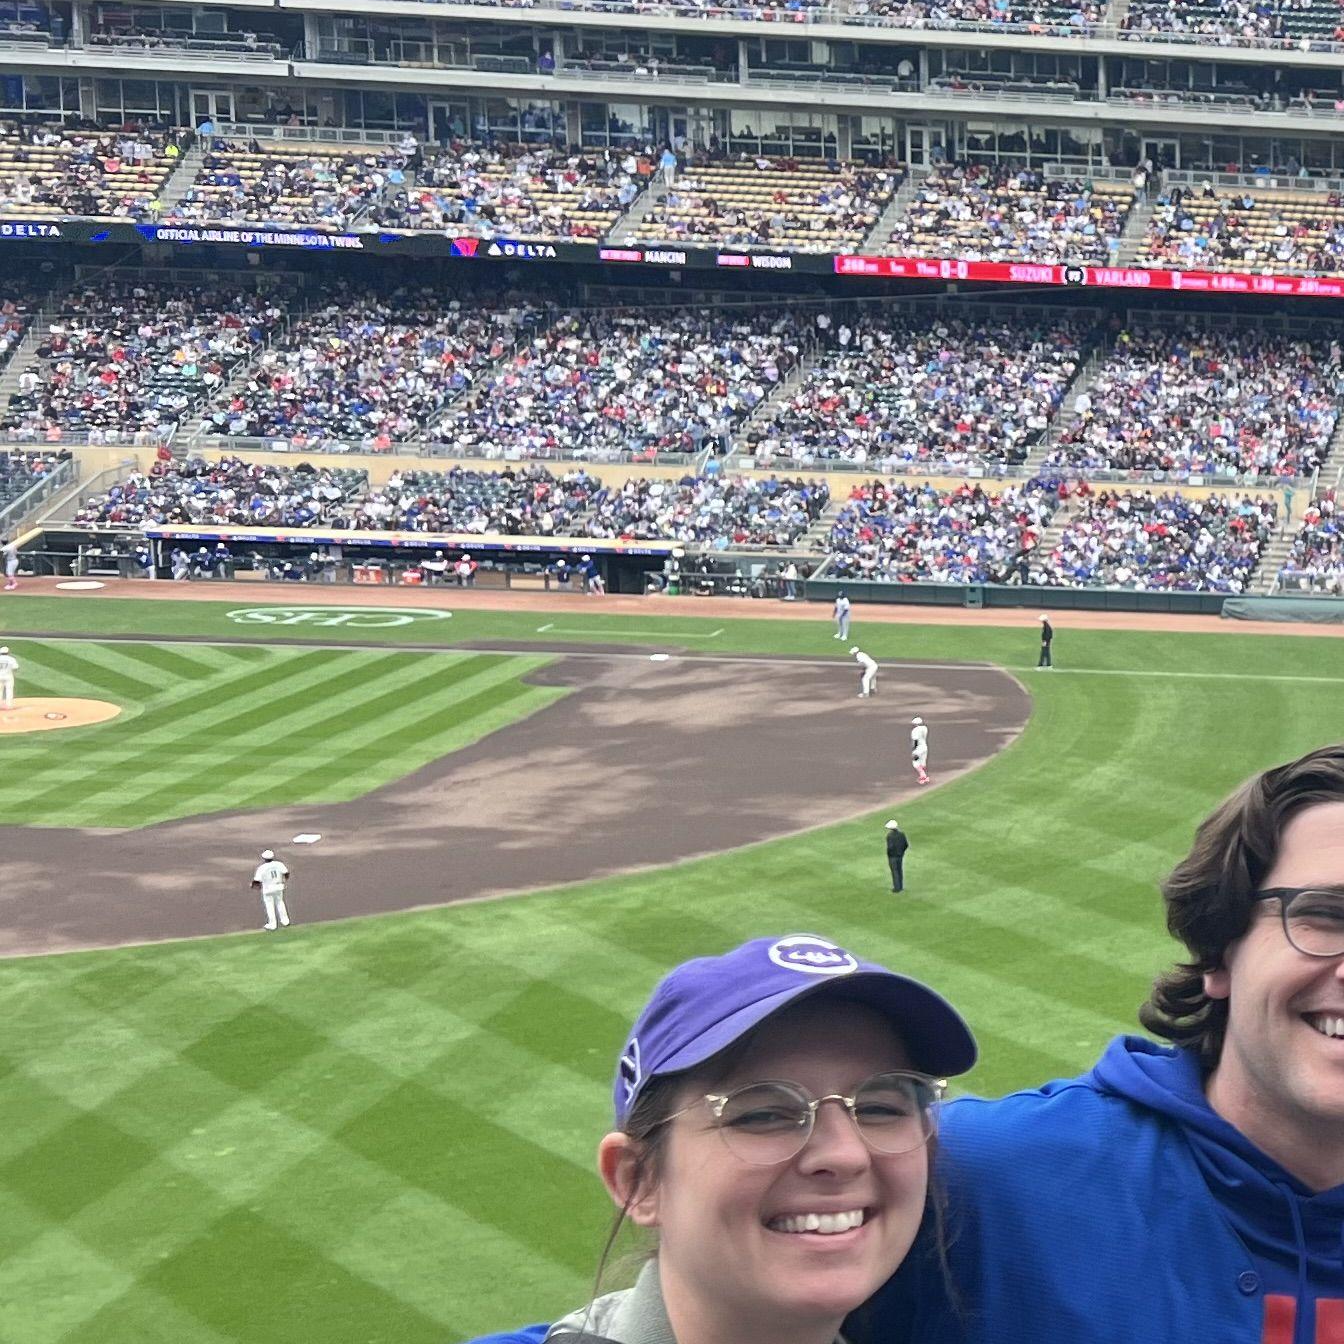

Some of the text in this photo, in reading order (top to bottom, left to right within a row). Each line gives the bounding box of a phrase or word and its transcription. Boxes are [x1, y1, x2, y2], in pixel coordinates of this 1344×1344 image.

[1, 224, 61, 237] DELTA
[157, 229, 199, 242] OFFICIAL
[201, 230, 240, 243] AIRLINE
[505, 244, 556, 257] DELTA
